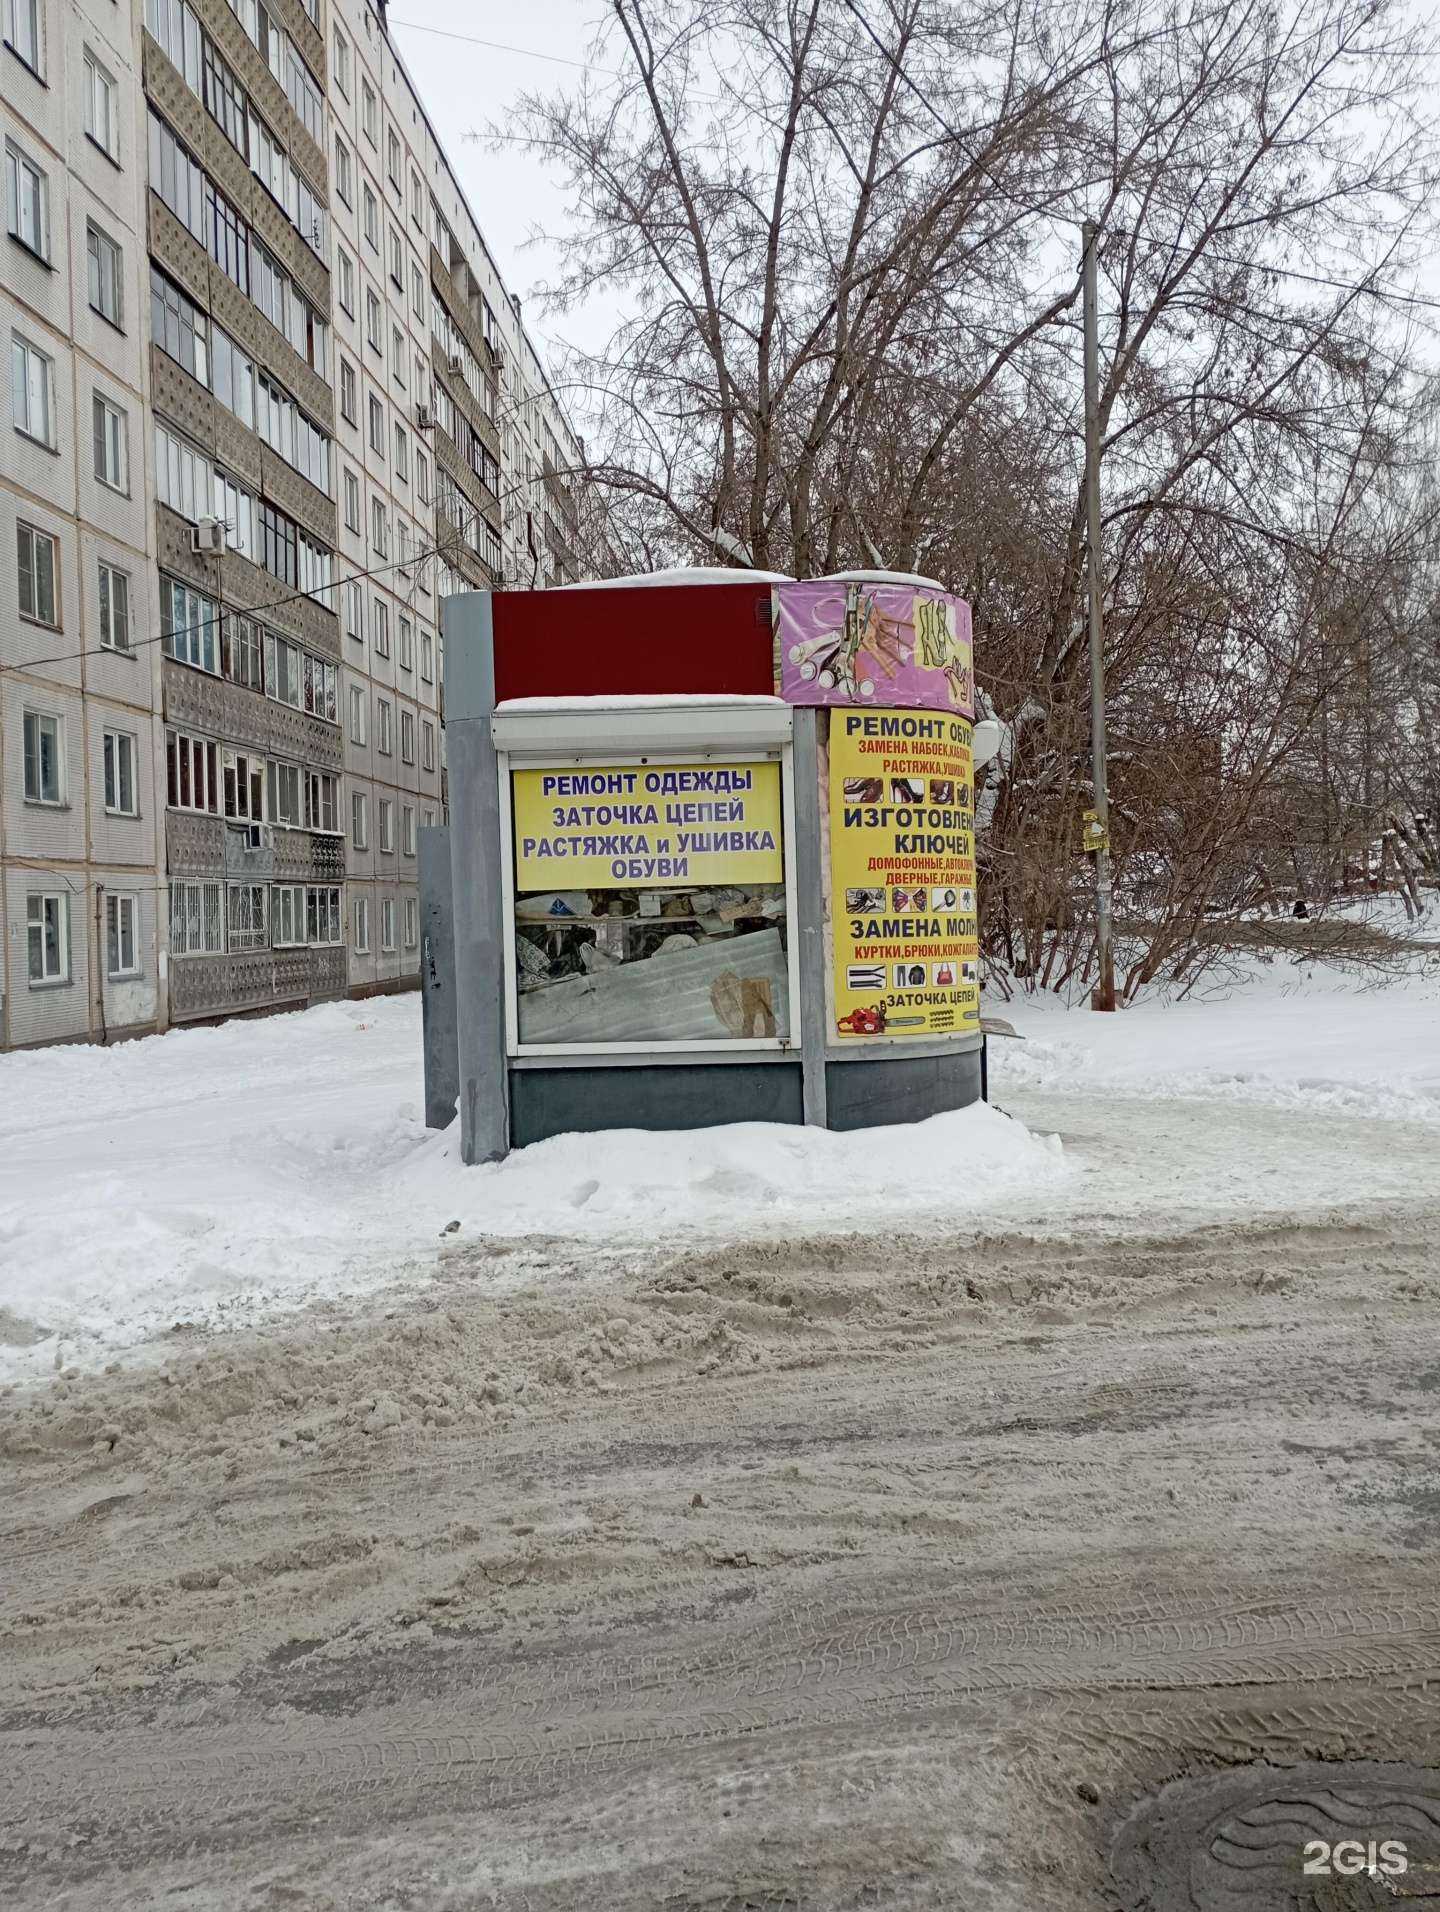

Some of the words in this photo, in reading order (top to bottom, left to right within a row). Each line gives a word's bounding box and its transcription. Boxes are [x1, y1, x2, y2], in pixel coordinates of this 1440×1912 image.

[846, 717, 945, 738] РЕМОНТ
[859, 740, 908, 754] ЗАМЕНА
[543, 774, 637, 796] РЕМОНТ
[645, 770, 752, 795] ОДЕЖДЫ
[553, 805, 658, 827] ЗАТОЧКА
[666, 797, 744, 826] ЦЕПЕЙ
[523, 835, 649, 857] РАСТЯЖКА
[657, 839, 669, 853] и
[677, 831, 775, 853] УШИВКА
[895, 834, 969, 855] КЛЮЧЕЙ
[612, 858, 688, 878] ОБУВИ
[850, 919, 942, 939] ЗАМЕНА
[887, 993, 947, 1007] ЗАТОЧКА
[950, 987, 975, 1005] ЦЕПЕЙ
